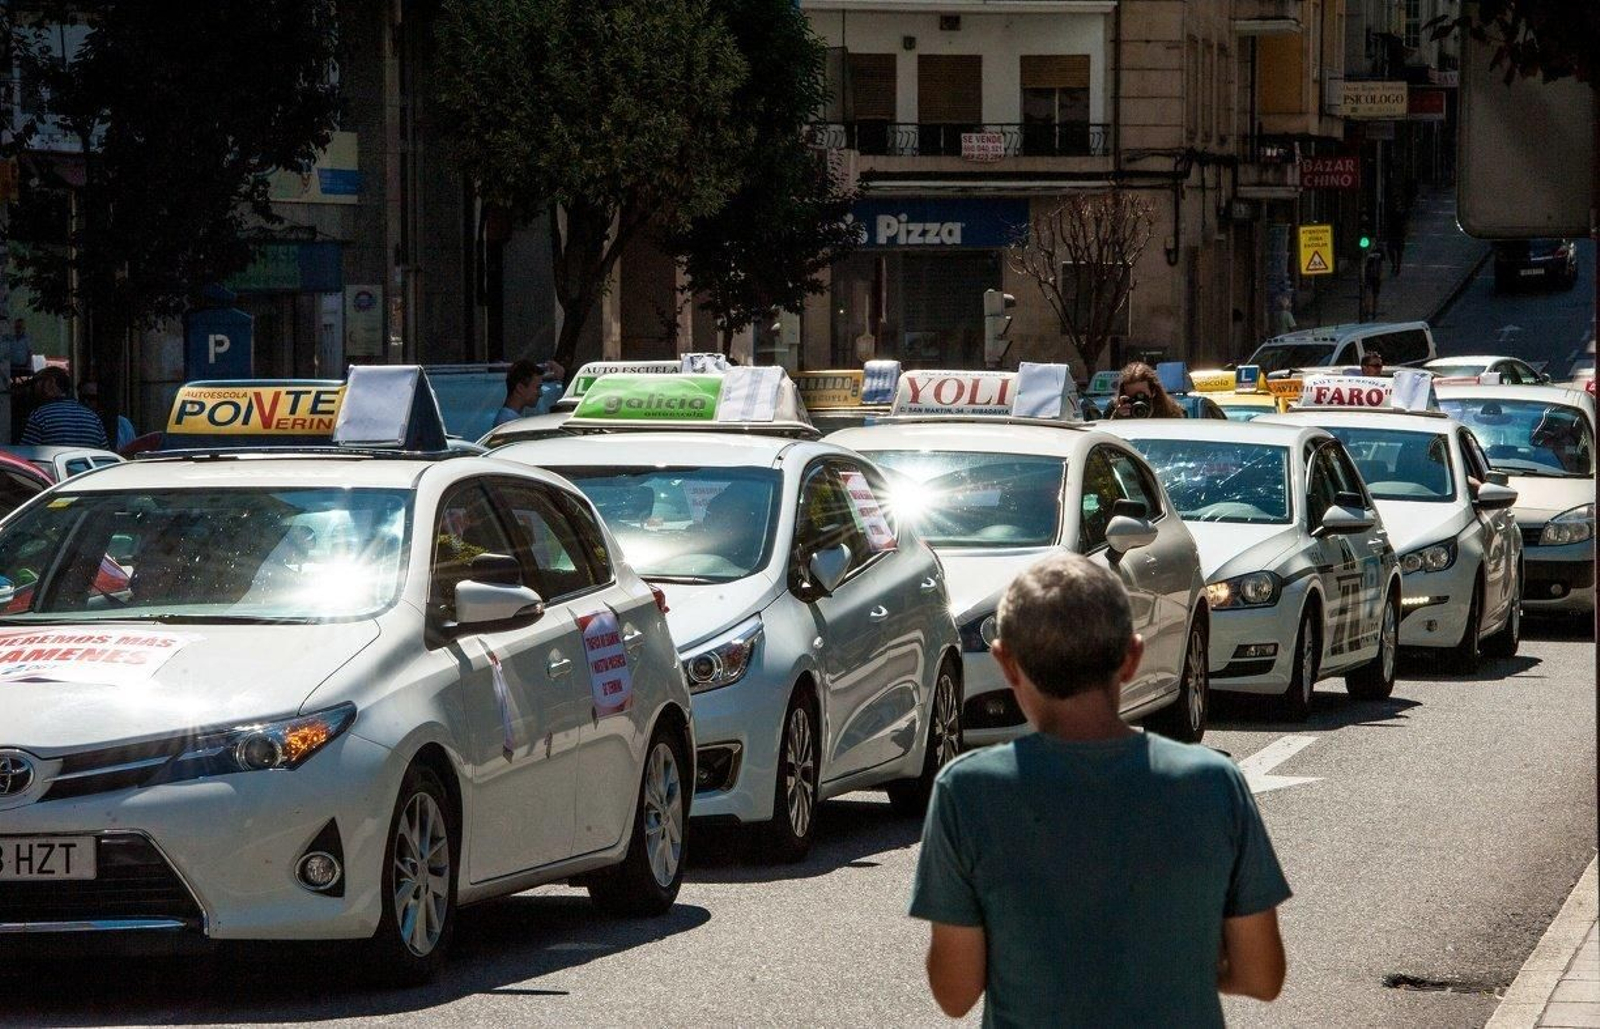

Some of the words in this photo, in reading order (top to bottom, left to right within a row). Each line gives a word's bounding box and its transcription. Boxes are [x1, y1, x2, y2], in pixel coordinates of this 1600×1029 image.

[1343, 93, 1404, 105] PSICOLOGO
[963, 135, 973, 143] SE
[975, 135, 1002, 144] VENDE
[1302, 159, 1354, 172] BAZAR
[1303, 174, 1352, 187] CHINO
[876, 213, 962, 245] Pizza
[208, 333, 231, 364] P
[583, 366, 619, 374] AUTO
[621, 366, 680, 374] ESCUELA
[184, 391, 248, 399] AUTOESCOLA
[906, 376, 1012, 406] YOLI
[603, 393, 707, 414] galicia
[16, 843, 77, 875] HZT
